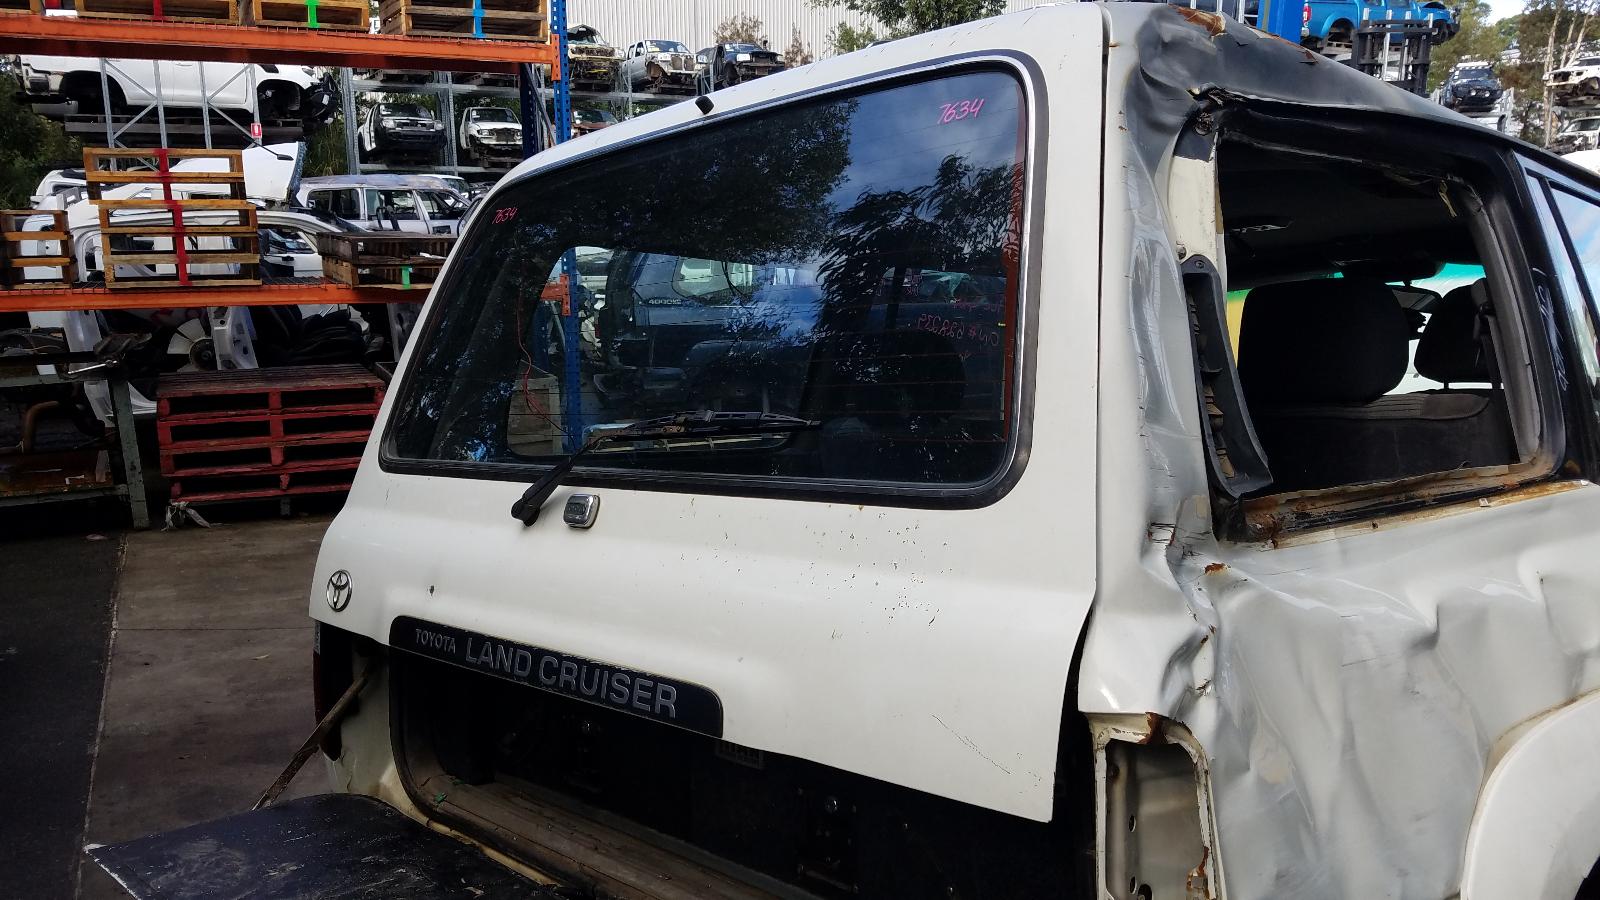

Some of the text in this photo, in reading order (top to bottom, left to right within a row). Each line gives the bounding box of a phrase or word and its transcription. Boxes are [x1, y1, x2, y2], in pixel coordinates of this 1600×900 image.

[937, 98, 985, 125] 7634
[415, 628, 677, 719] TOYOTA LAND CRUISER
